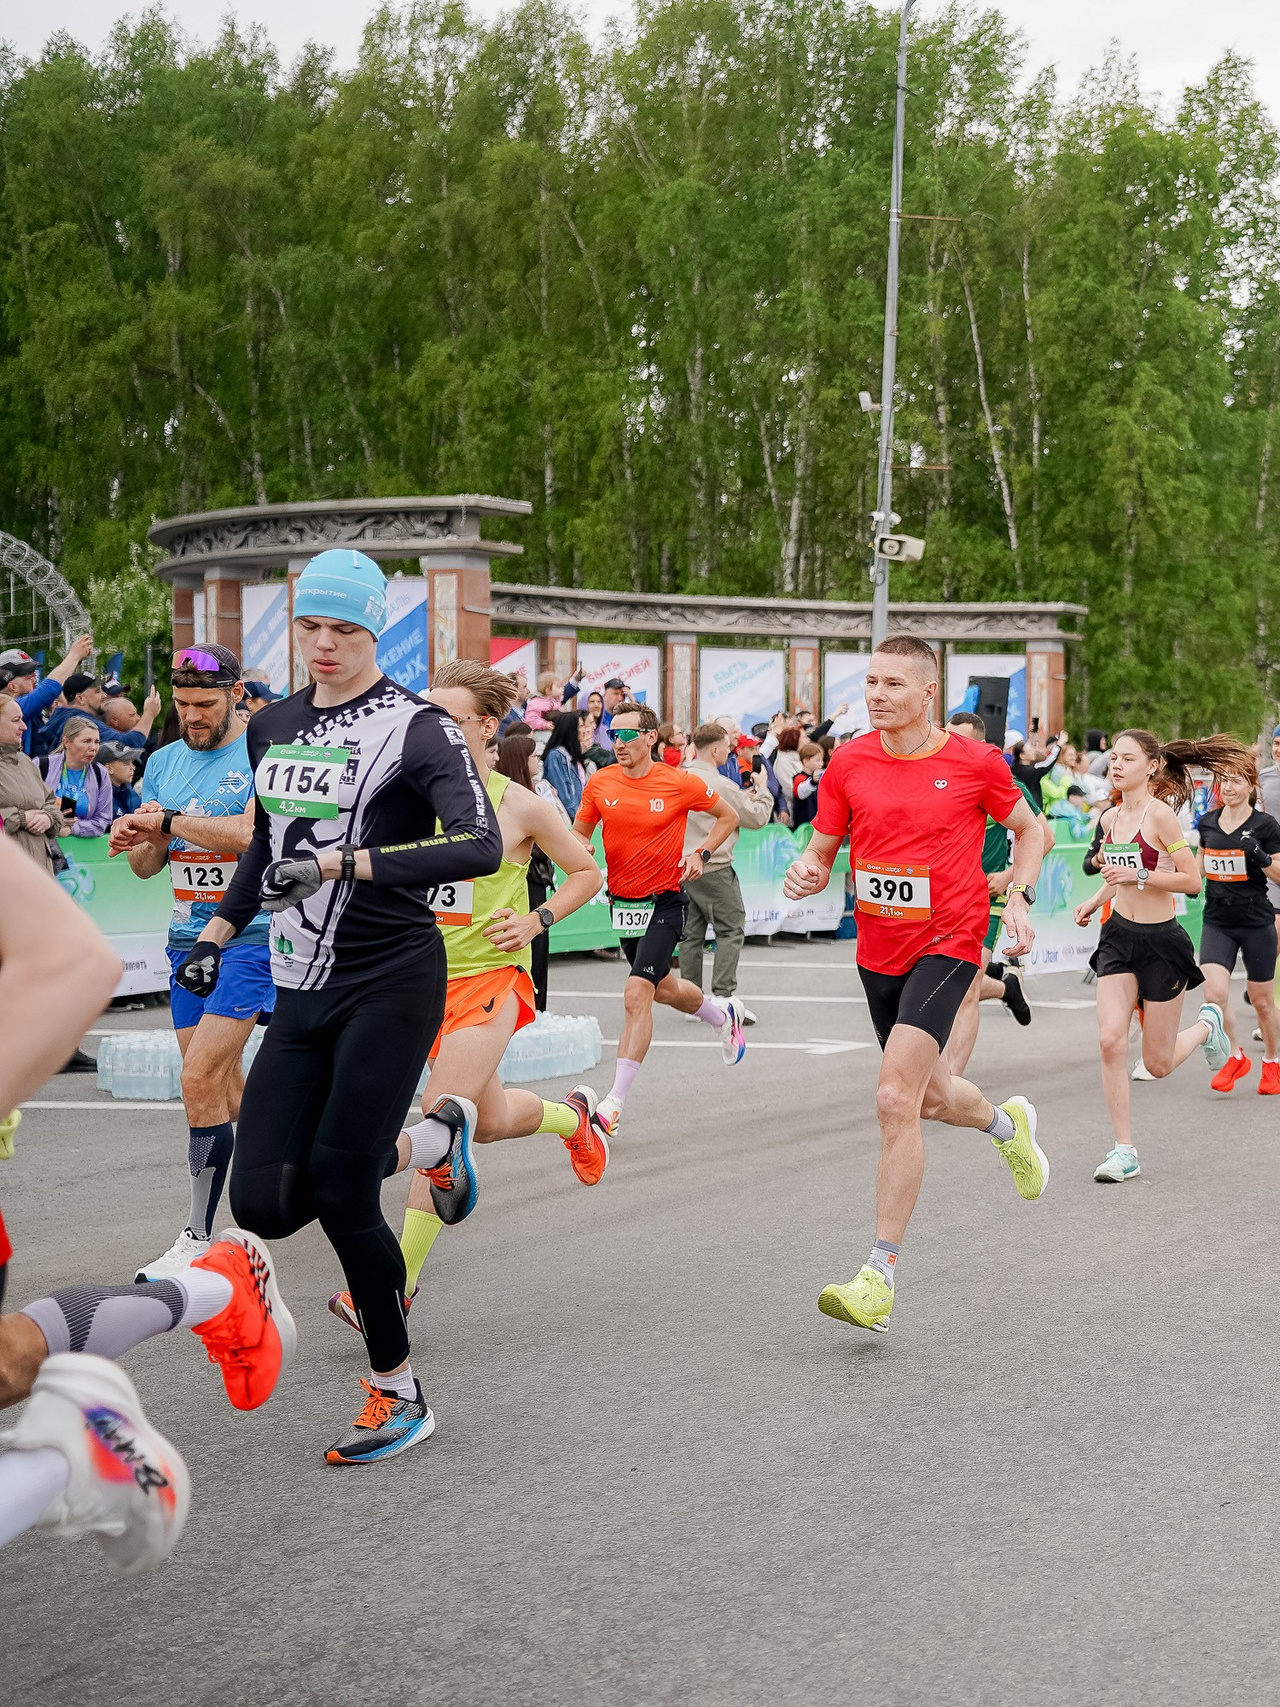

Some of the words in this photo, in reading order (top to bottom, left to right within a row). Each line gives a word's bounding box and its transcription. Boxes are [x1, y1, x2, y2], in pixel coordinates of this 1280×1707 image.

[712, 660, 748, 683] БЫТЬ
[266, 763, 332, 796] 1154
[649, 798, 664, 812] 10
[380, 842, 418, 854] HARD
[420, 837, 449, 848] RUN
[1211, 859, 1235, 872] 311
[183, 866, 224, 887] 123
[869, 877, 913, 902] 390
[618, 912, 649, 926] 1330
